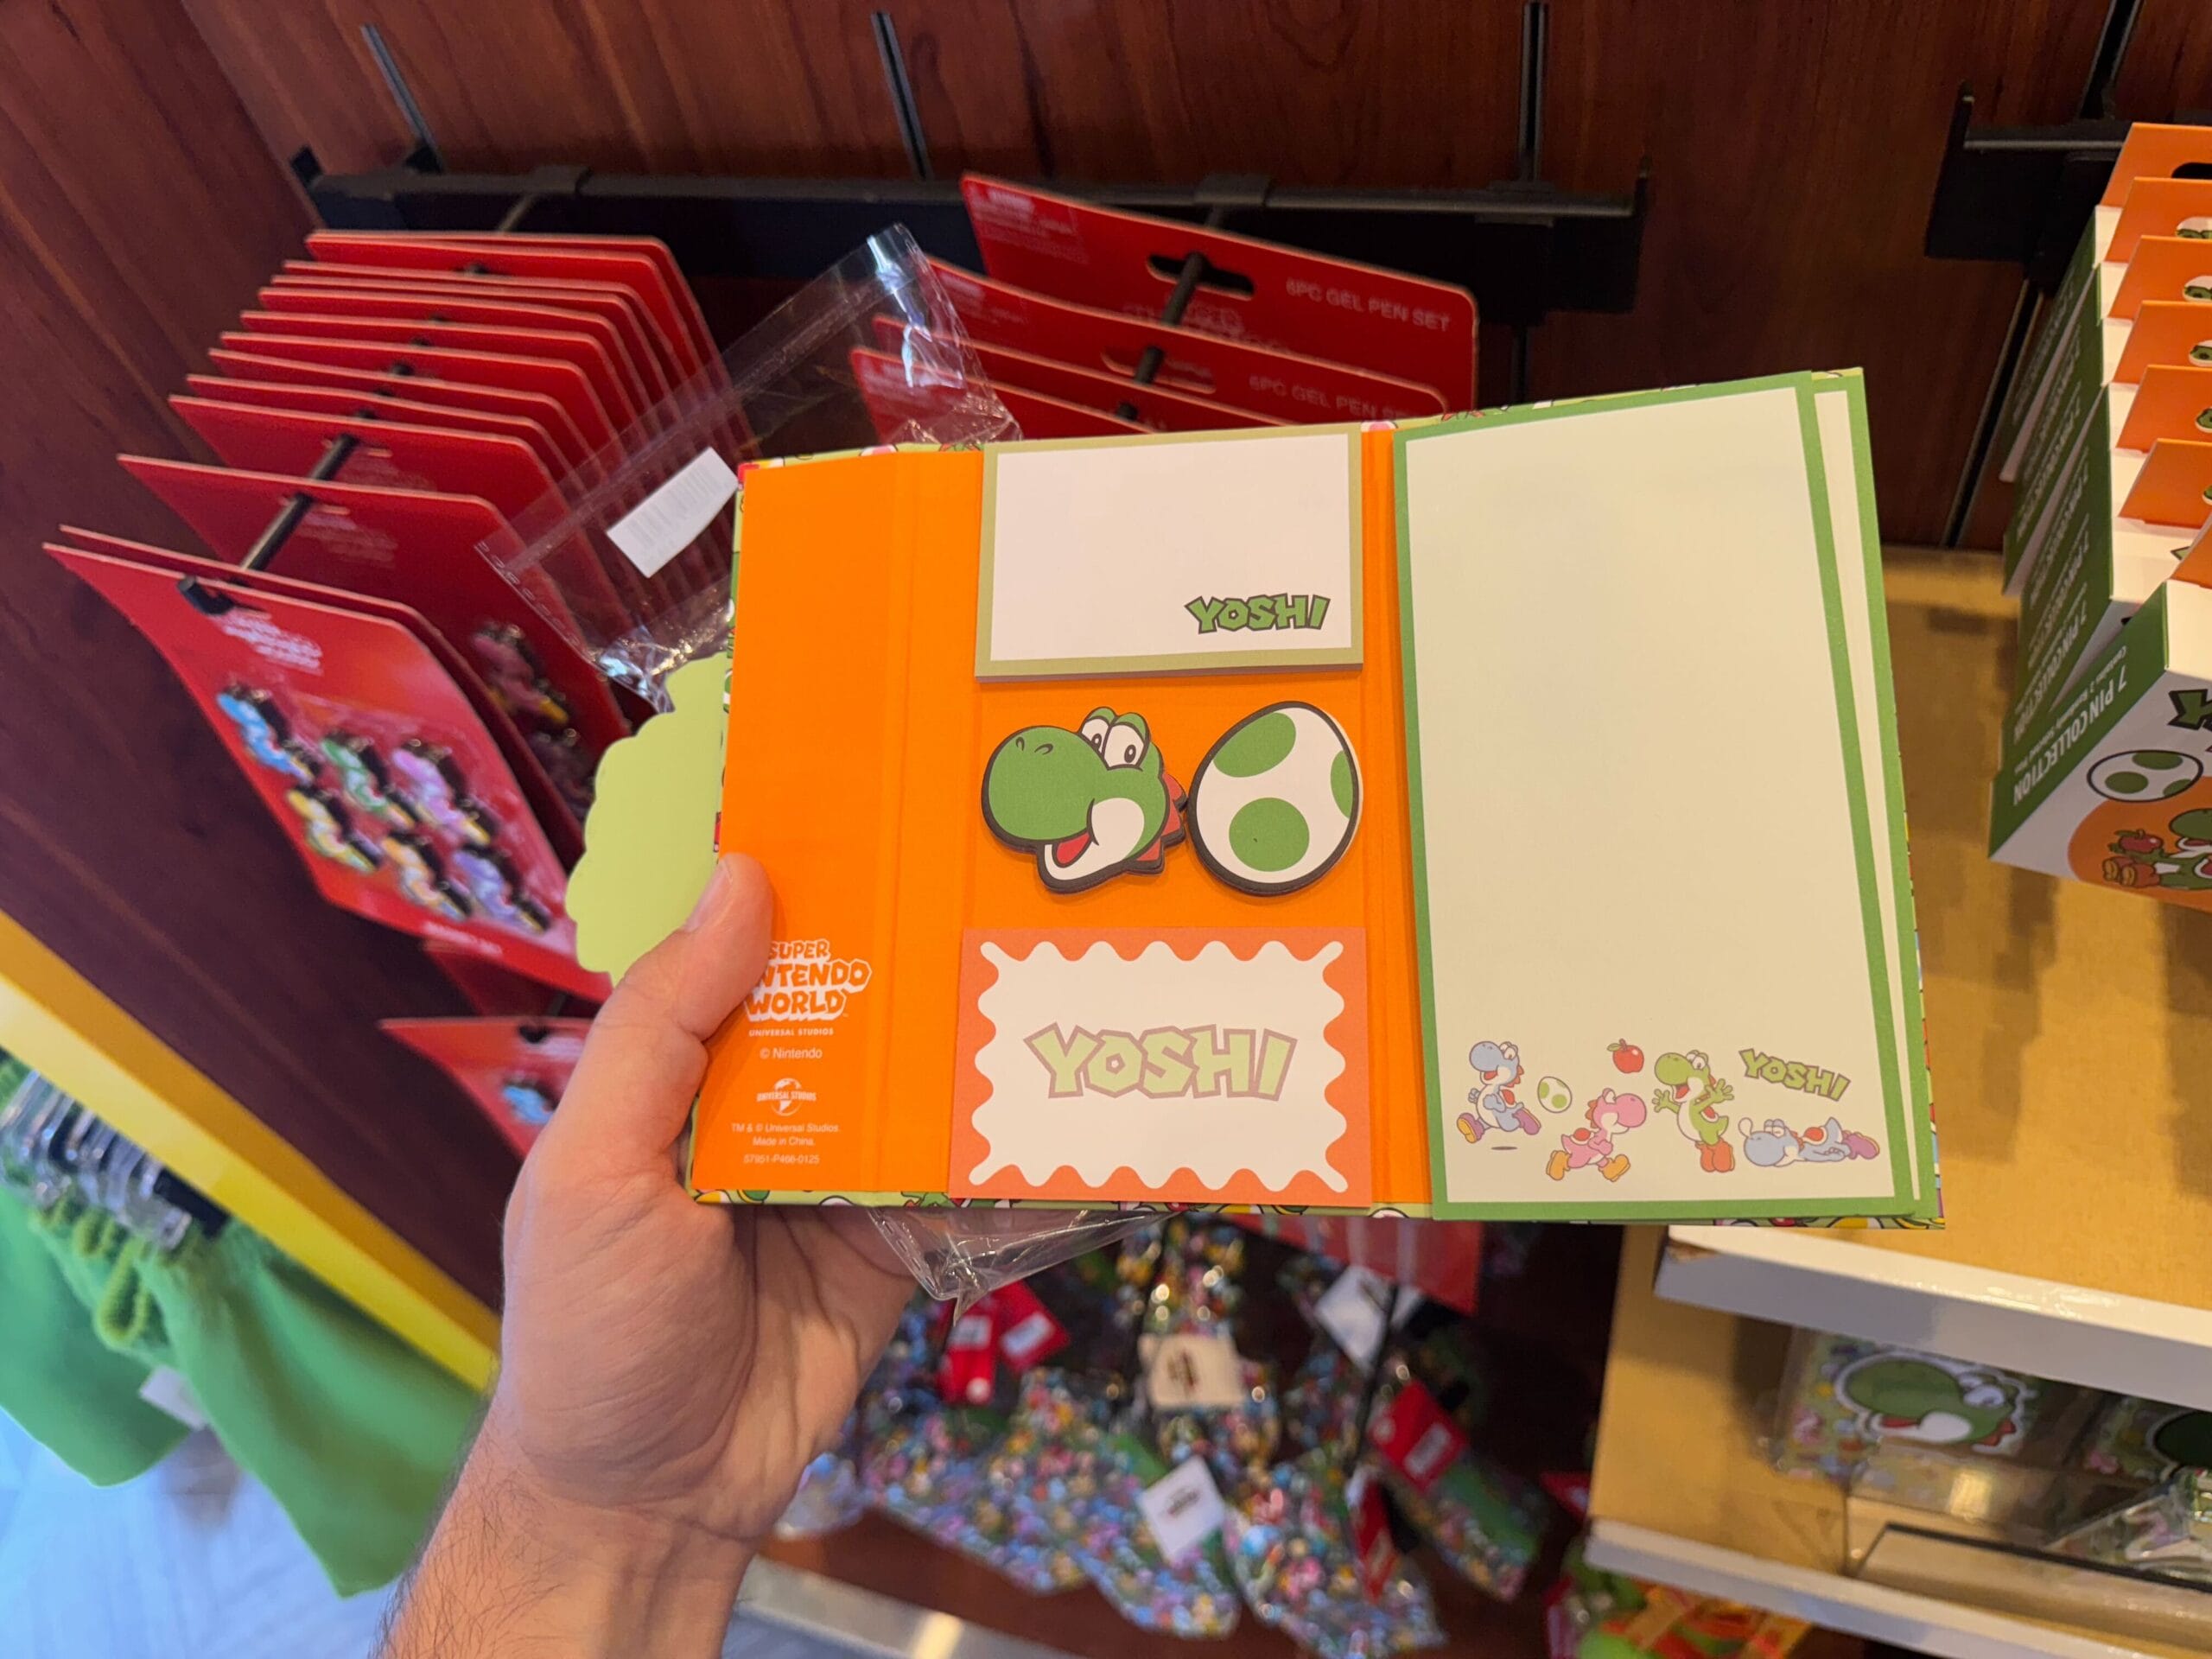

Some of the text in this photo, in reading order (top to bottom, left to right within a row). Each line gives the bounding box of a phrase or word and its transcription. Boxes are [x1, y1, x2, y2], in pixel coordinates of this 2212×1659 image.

[1326, 288, 1363, 312] GEL
[1368, 297, 1408, 321] PEN
[1412, 308, 1451, 332] SET
[1292, 385, 1330, 408] GEL
[1184, 593, 1332, 634] YOSHI
[2013, 664, 2127, 805] 7 PIN COLLECTION
[753, 958, 873, 994] NTENDO
[744, 989, 847, 1021] WORLD
[748, 1027, 834, 1037] UNIVERSAL STUDIOS
[772, 1047, 823, 1059] Nintendo
[1023, 1021, 1298, 1101] YOSHI
[1738, 1048, 1851, 1102] YOSHI
[753, 1136, 777, 1147] Made
[765, 1122, 804, 1133] Universal
